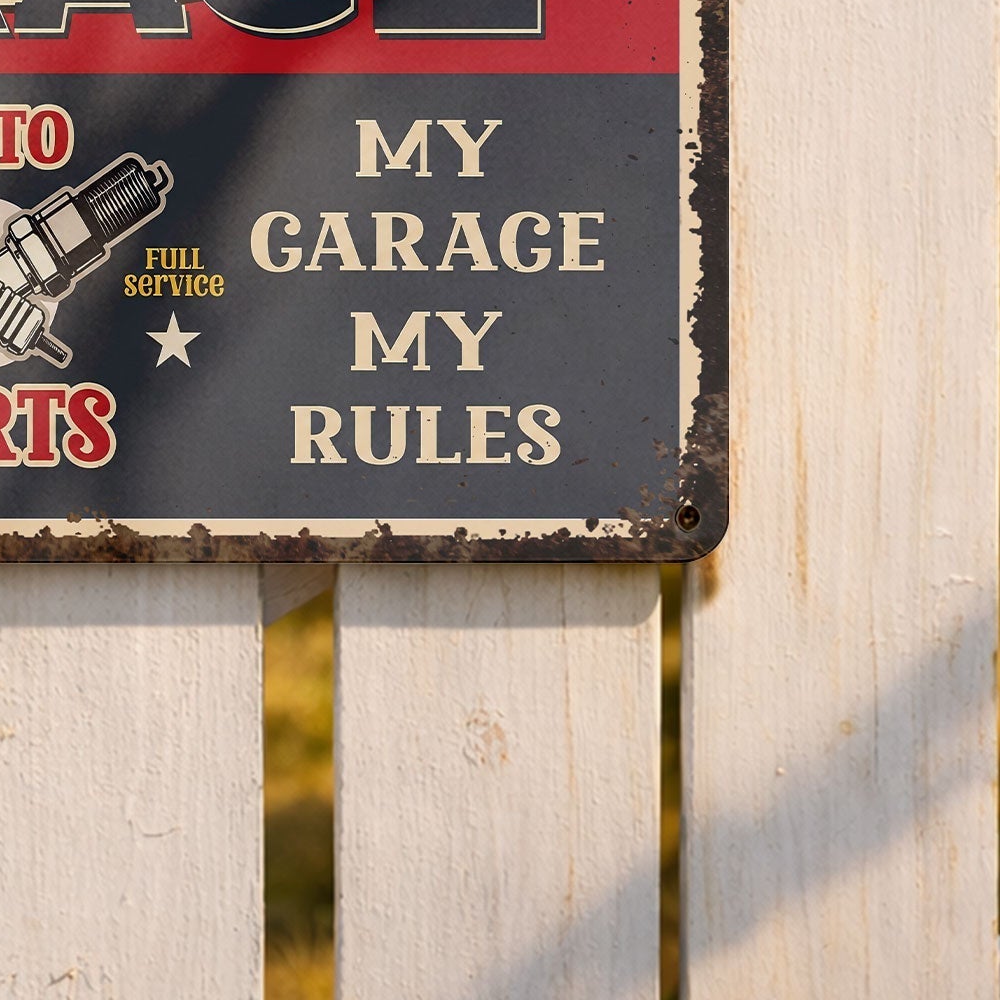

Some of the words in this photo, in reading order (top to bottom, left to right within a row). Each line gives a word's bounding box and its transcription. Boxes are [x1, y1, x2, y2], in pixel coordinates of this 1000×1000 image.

[354, 119, 503, 178] MY
[144, 247, 205, 271] FULL
[250, 210, 605, 274] GARAGE
[123, 271, 226, 299] service
[350, 311, 503, 371] MY
[290, 404, 562, 466] RULES
